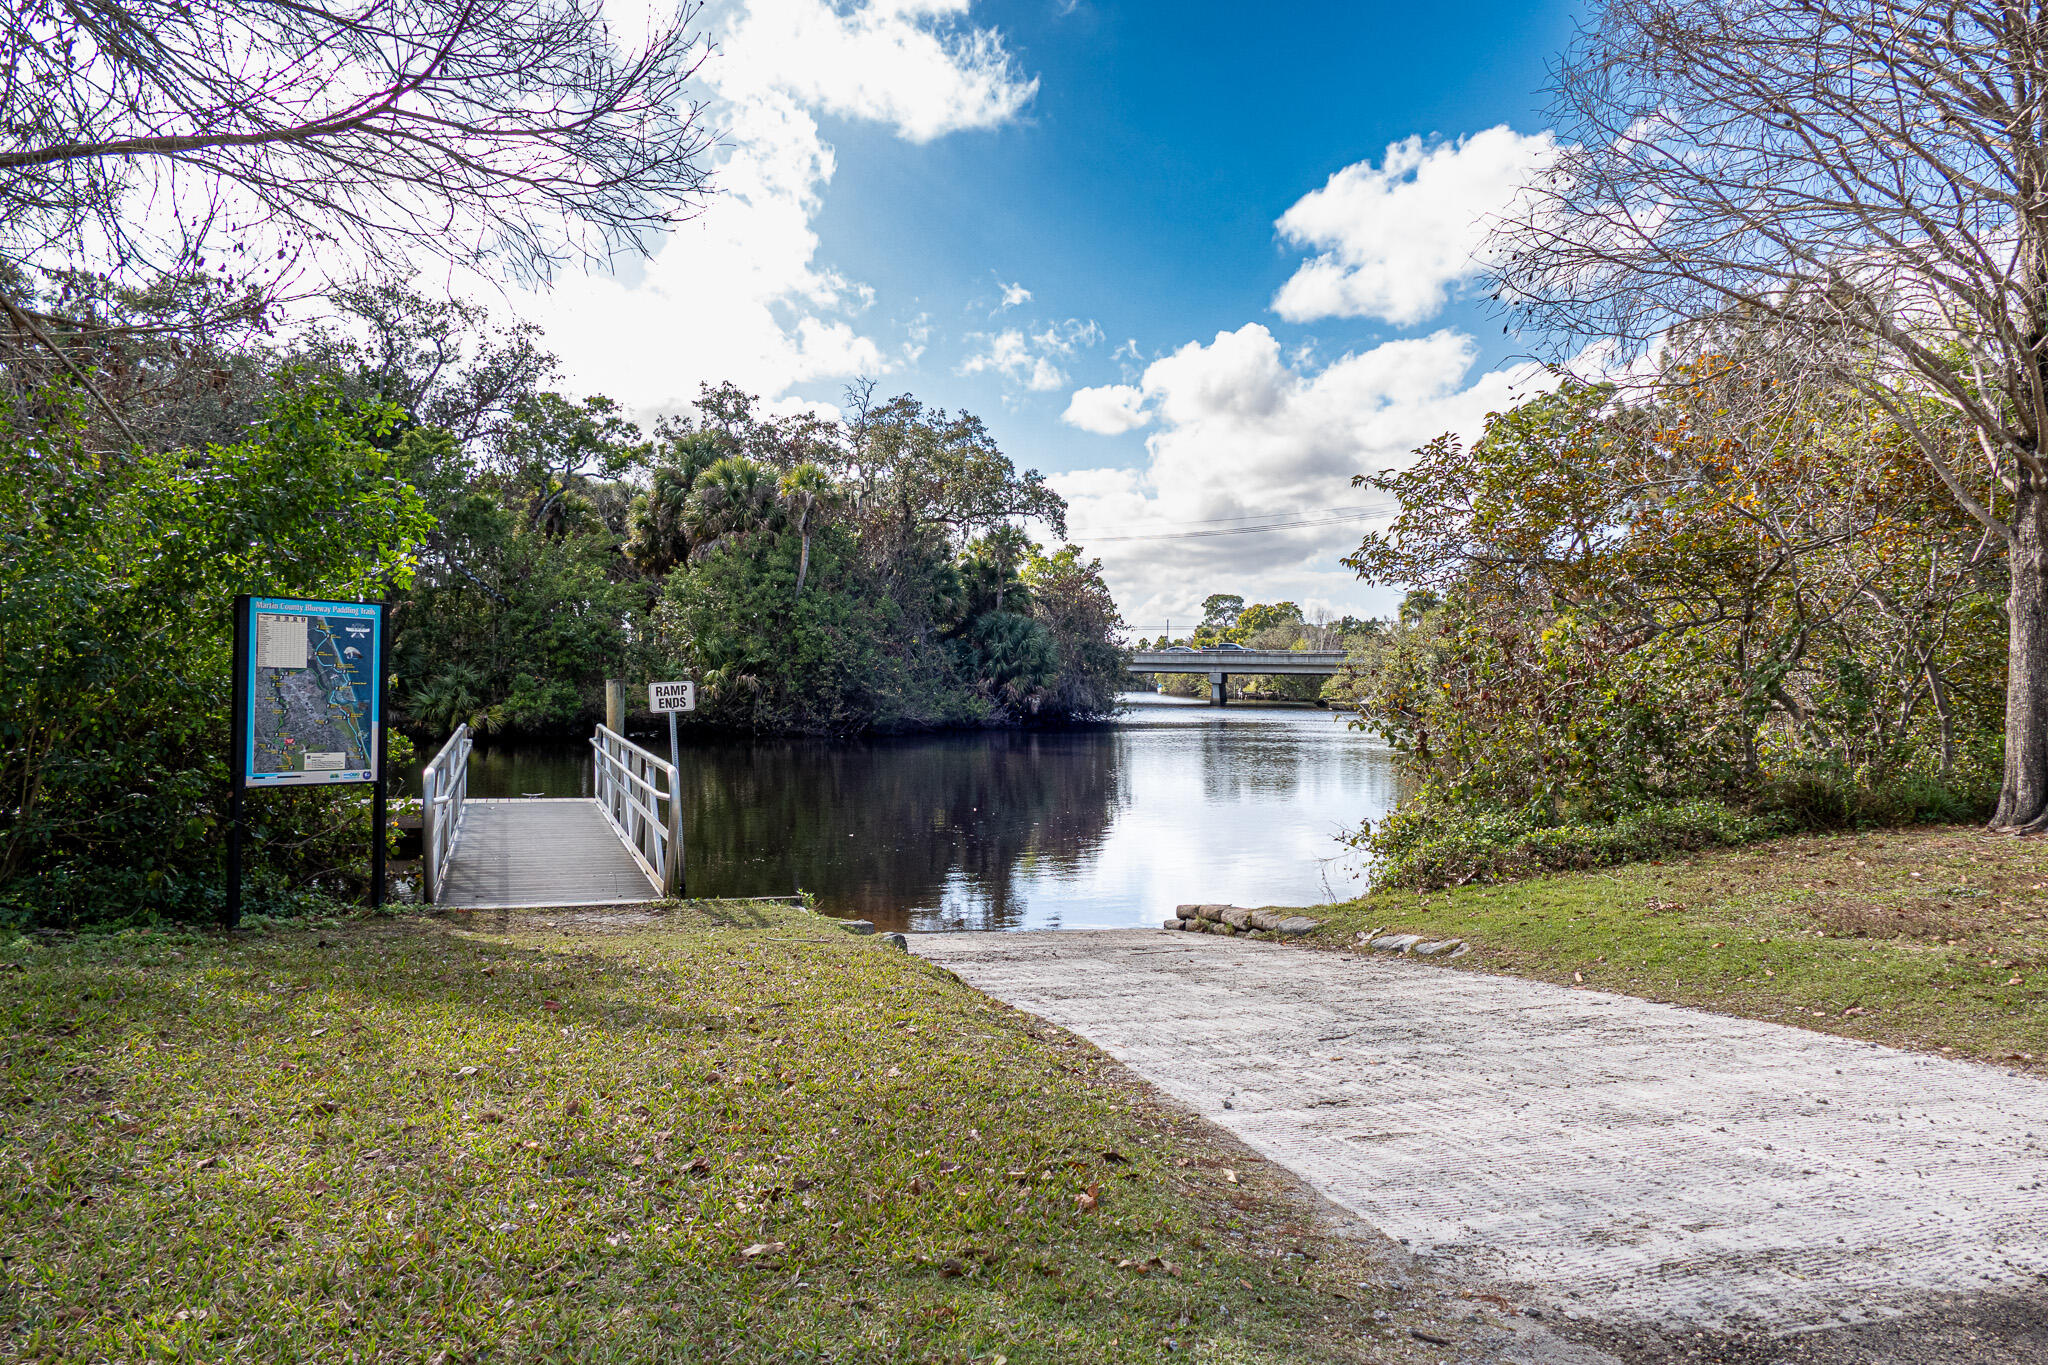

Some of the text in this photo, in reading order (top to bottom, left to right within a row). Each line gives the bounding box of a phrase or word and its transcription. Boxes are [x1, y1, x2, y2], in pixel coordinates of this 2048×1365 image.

[256, 601, 376, 615] Martin County Blueway Paddling Trails
[655, 685, 687, 696] RAMP
[658, 697, 686, 709] ENDS
